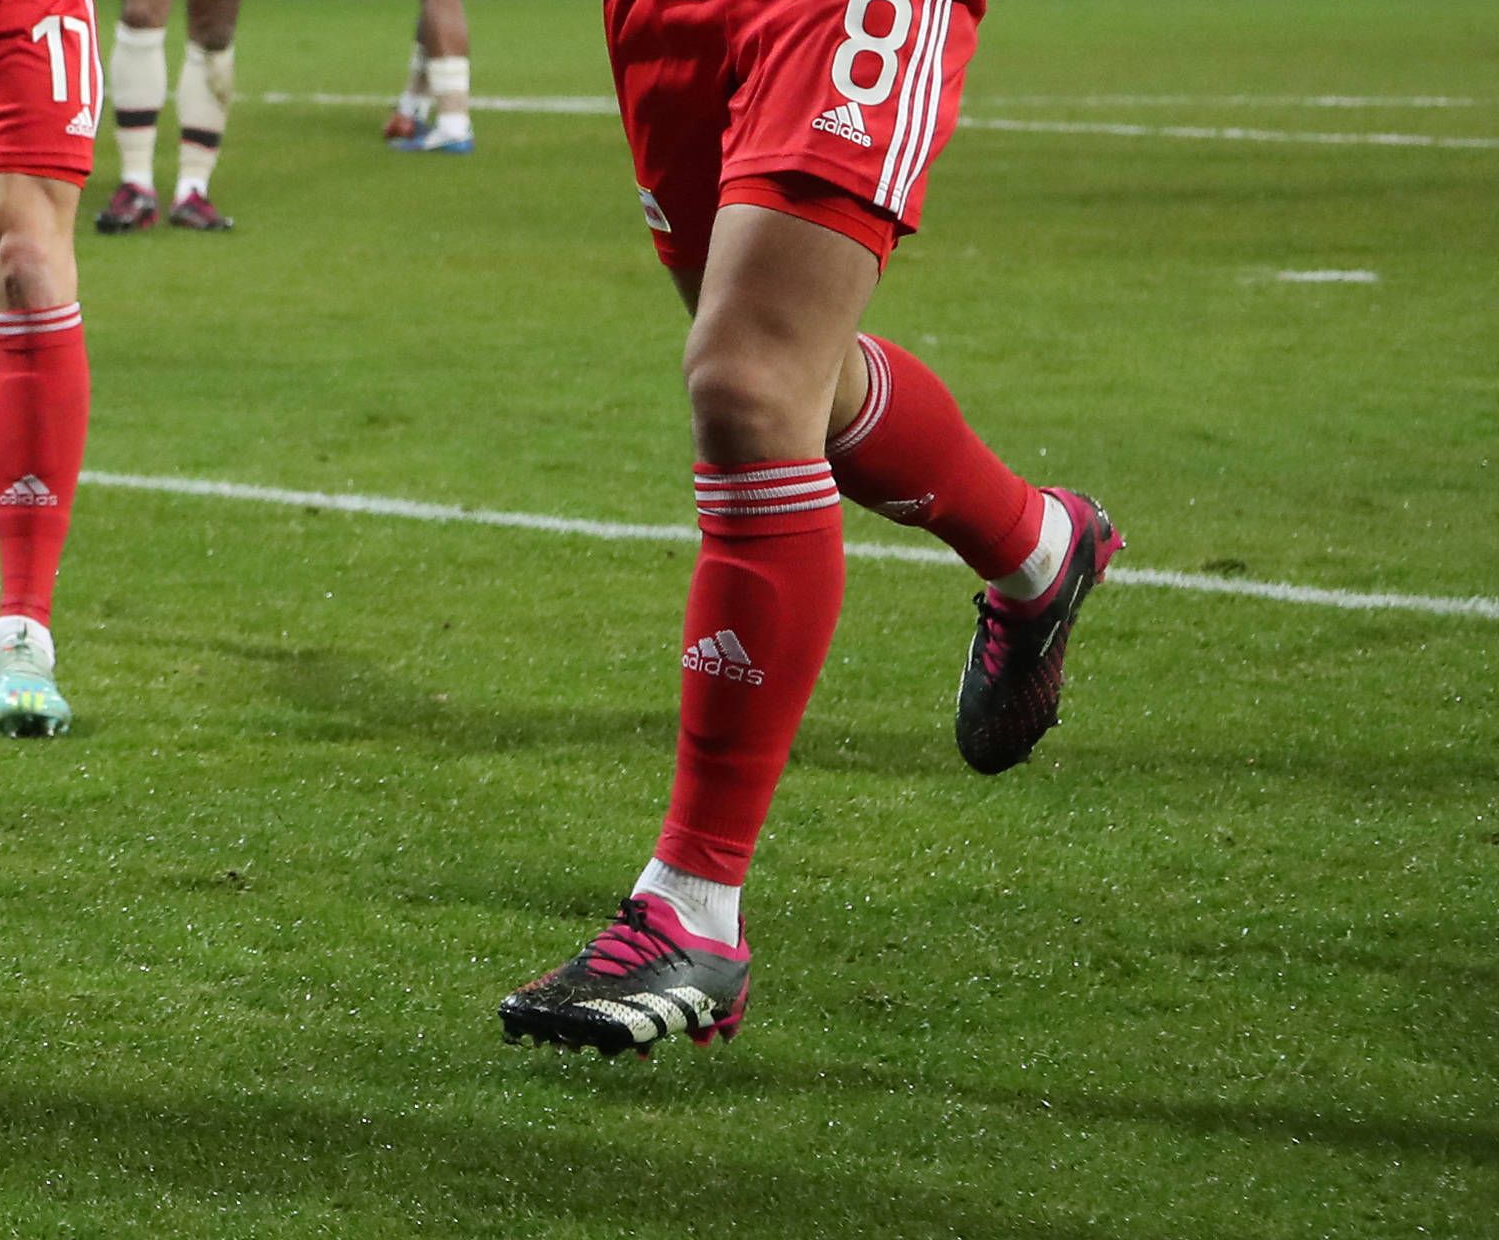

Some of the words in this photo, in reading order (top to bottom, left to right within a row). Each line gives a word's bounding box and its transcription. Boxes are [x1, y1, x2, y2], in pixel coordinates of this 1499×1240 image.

[31, 15, 91, 105] 17
[811, 115, 873, 148] adidas
[0, 492, 59, 507] adidas
[681, 653, 765, 686] adidas
